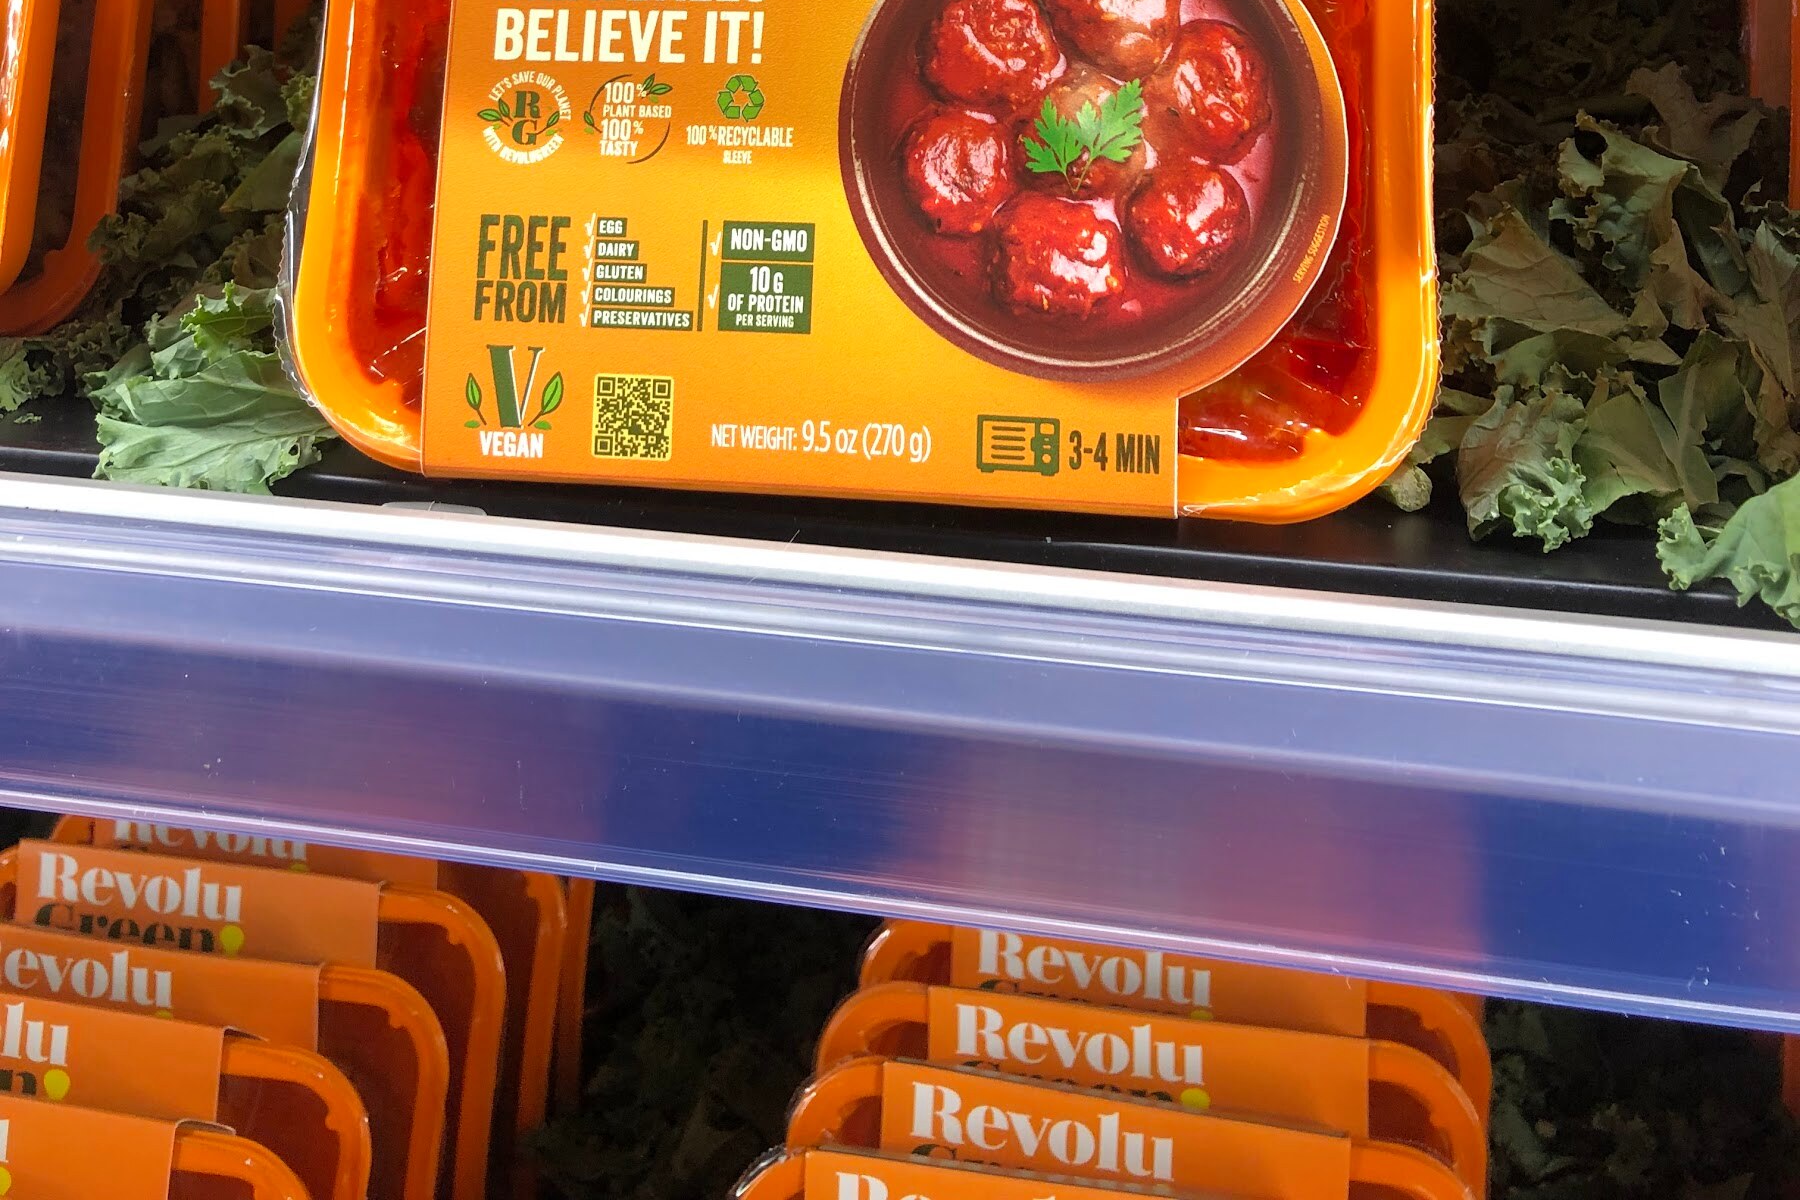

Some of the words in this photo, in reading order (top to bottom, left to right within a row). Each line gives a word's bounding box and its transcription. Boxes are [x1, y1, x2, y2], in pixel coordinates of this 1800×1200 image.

[494, 9, 688, 62] BELIEVE
[704, 11, 764, 64] IT!
[488, 77, 512, 101] LET'S
[512, 70, 536, 85] SAVE
[536, 72, 555, 90] OUR
[552, 85, 571, 121] PLANET
[604, 81, 647, 103] 100%
[603, 105, 636, 118] PLANT
[639, 105, 672, 119] BASED
[601, 119, 644, 140] 100%
[600, 140, 638, 156] TASTY
[723, 150, 752, 164] SLEEVE
[599, 220, 623, 234] EGG
[476, 214, 571, 281] FREE
[598, 243, 635, 257] DAIRY
[731, 228, 807, 252] NON-GMO
[596, 265, 644, 280] GLUTEN
[750, 266, 768, 292] 10
[474, 281, 567, 323] FROM
[595, 288, 672, 305] COLOURINGS
[727, 294, 745, 312] OF
[749, 294, 804, 313] PROTEIN
[593, 310, 690, 327] PRESERVATIVES
[736, 314, 754, 327] PER
[756, 315, 794, 328] SERVING
[479, 430, 544, 459] VEGAN
[711, 424, 738, 448] NET
[741, 425, 798, 451] WEIGHT:
[802, 419, 831, 452] 9.5
[835, 428, 858, 454] oz
[863, 422, 905, 461] (270
[909, 425, 932, 463] g)
[1069, 430, 1108, 473] 3-4
[1116, 434, 1160, 475] MIN
[37, 851, 242, 922] Revolu
[2, 948, 172, 1009] evolu
[978, 928, 1212, 1008] Revolu
[955, 1003, 1205, 1086] Revolu
[911, 1081, 1175, 1182] Revolu
